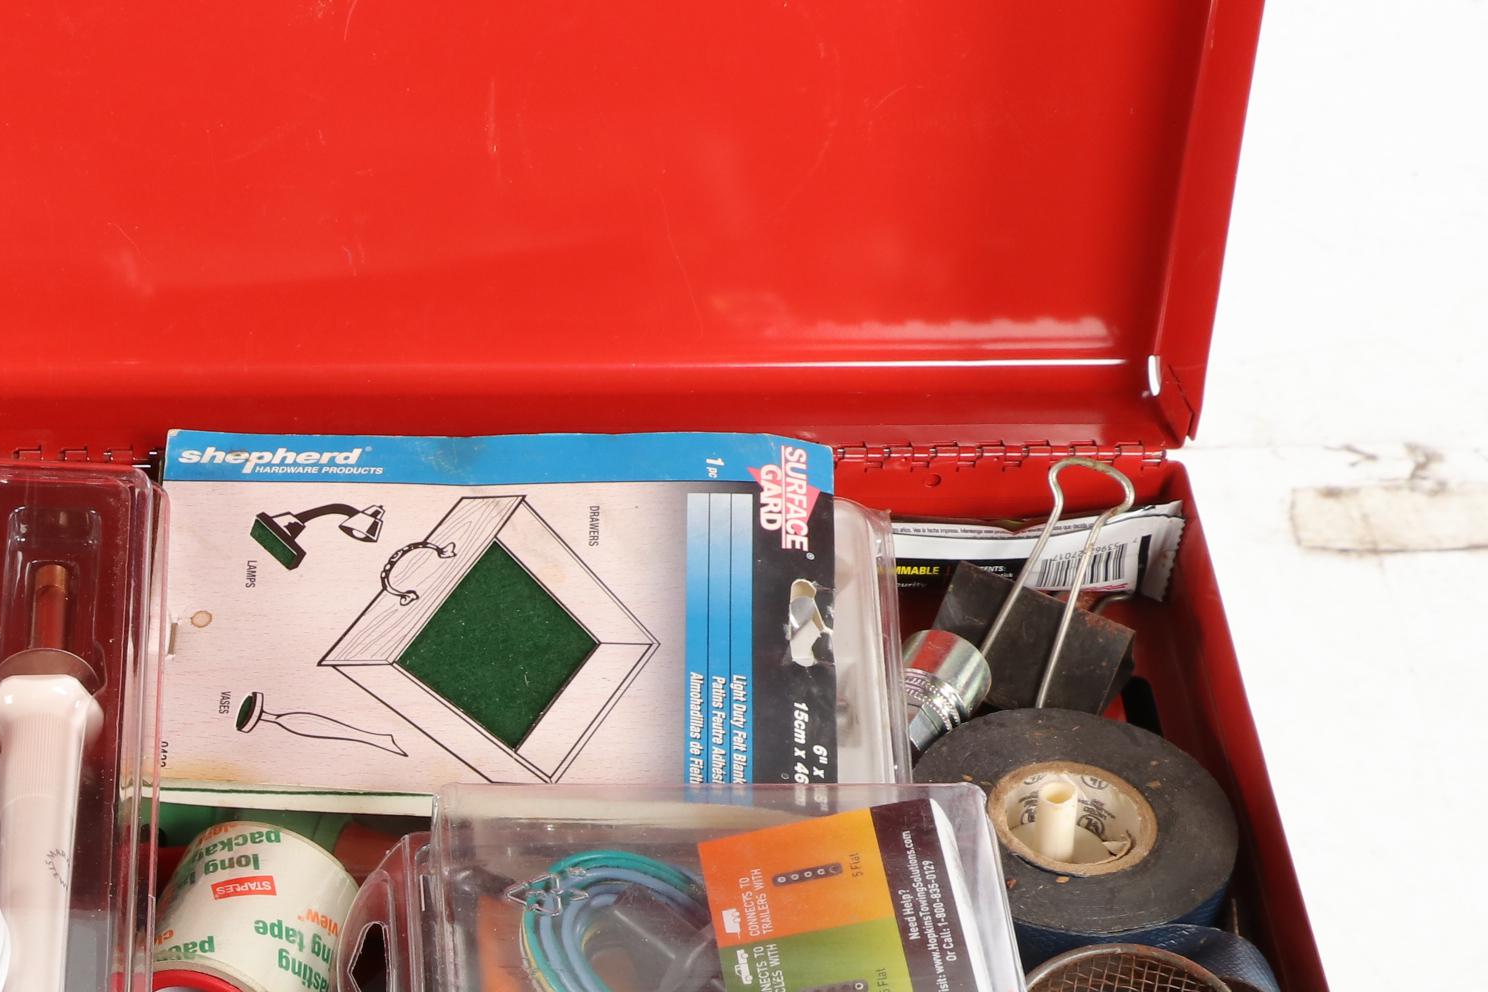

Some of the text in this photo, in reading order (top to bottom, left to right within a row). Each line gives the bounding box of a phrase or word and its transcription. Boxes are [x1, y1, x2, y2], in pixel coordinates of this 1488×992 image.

[178, 446, 363, 474] shepherd
[255, 465, 384, 475] HARDWARE PRODUCTS
[706, 457, 724, 479] 1 pc
[759, 464, 783, 532] GARD
[588, 505, 600, 547] DRAWERS
[245, 560, 257, 588] LAMPS
[711, 676, 725, 707] Patins
[731, 674, 748, 702] Light
[218, 691, 231, 714] VASES
[689, 672, 703, 739] Almohadillas
[731, 703, 748, 728] Duty
[711, 709, 725, 743] Feutre
[794, 701, 809, 744] 15cm
[689, 741, 703, 754] de
[731, 730, 748, 751] Felt
[794, 747, 808, 760] x
[813, 744, 828, 765] 6"
[813, 766, 827, 779] x
[203, 853, 260, 875] long
[215, 880, 272, 895] STAPLES
[753, 868, 773, 934] TRAILERS WITH
[739, 877, 760, 937] CONNECTS TO
[899, 889, 920, 940] Need Help?
[902, 831, 943, 974] www.HopkinsTowingSolutions.com
[923, 860, 957, 962] Or Call: 1-800-835-0129
[254, 920, 305, 953] tape
[753, 946, 764, 959] TO
[769, 944, 780, 970] WITH
